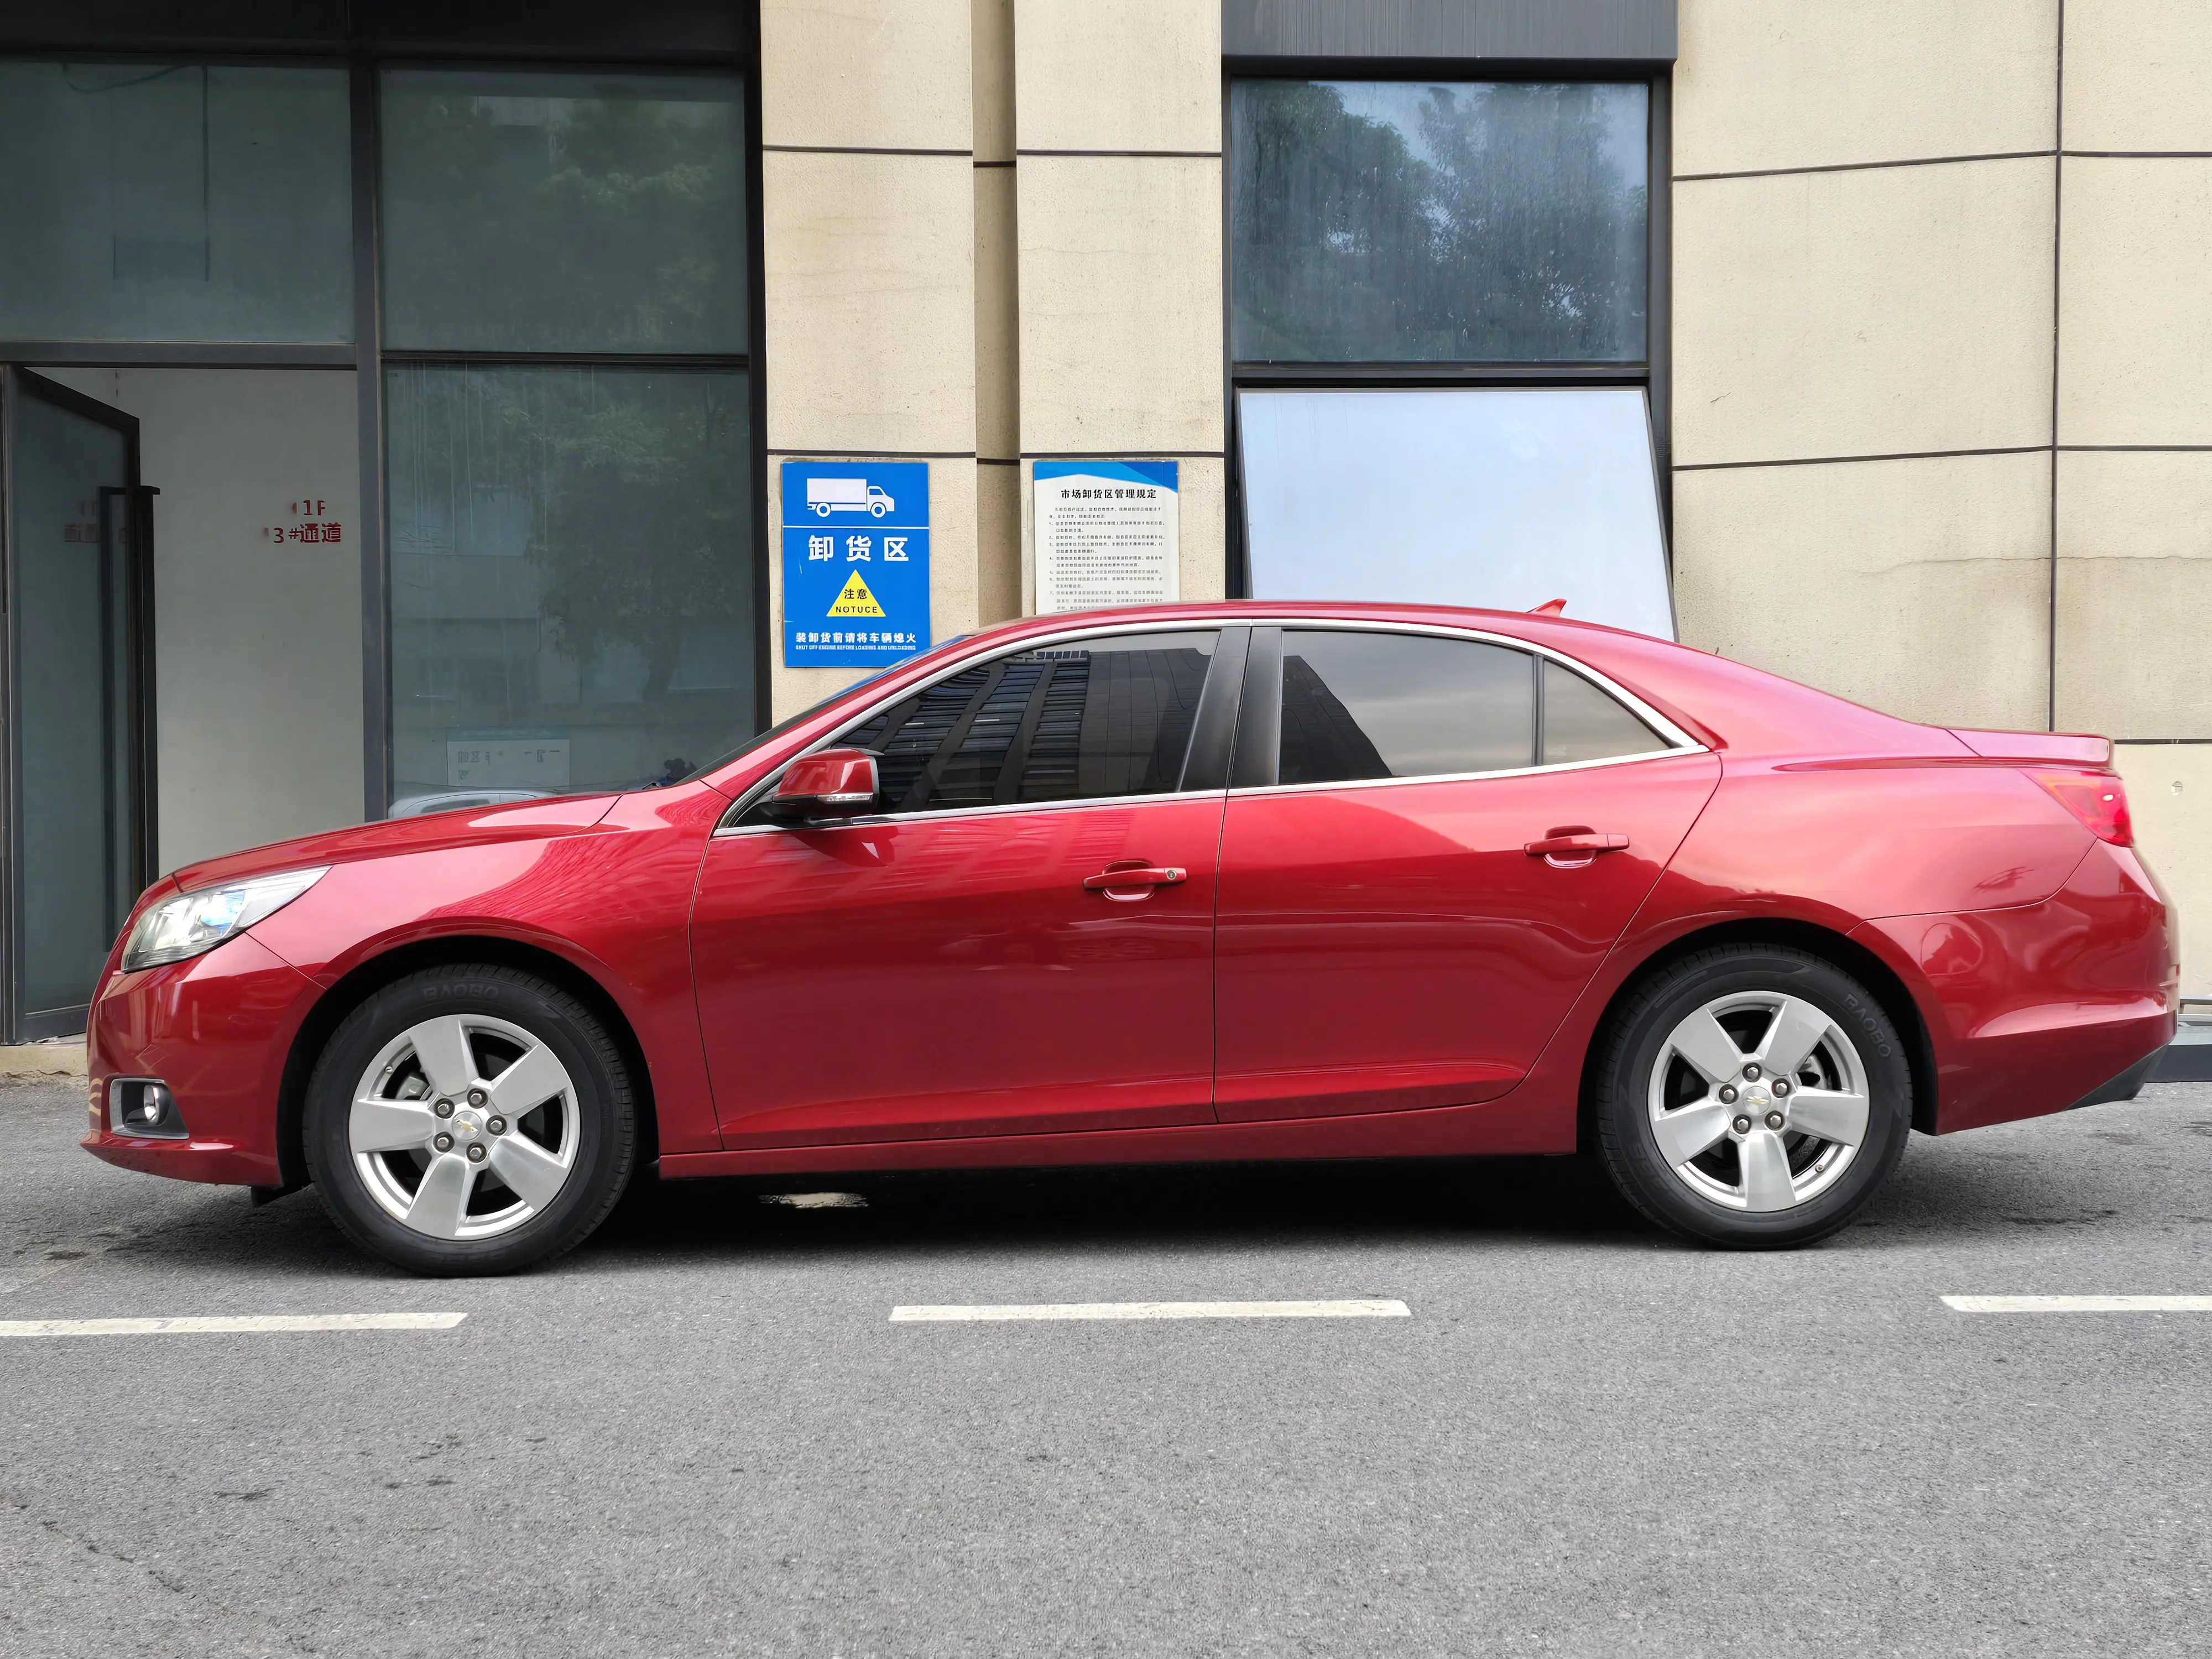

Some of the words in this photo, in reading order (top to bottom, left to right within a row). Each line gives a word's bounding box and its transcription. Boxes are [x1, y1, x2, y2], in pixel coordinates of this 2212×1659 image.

[1061, 489, 1156, 499] 市场卸货区管理规定
[303, 500, 326, 516] 1F
[808, 535, 909, 562] 卸货区
[844, 588, 868, 599] 注意
[796, 632, 916, 643] 装卸货前请将车辆熄火
